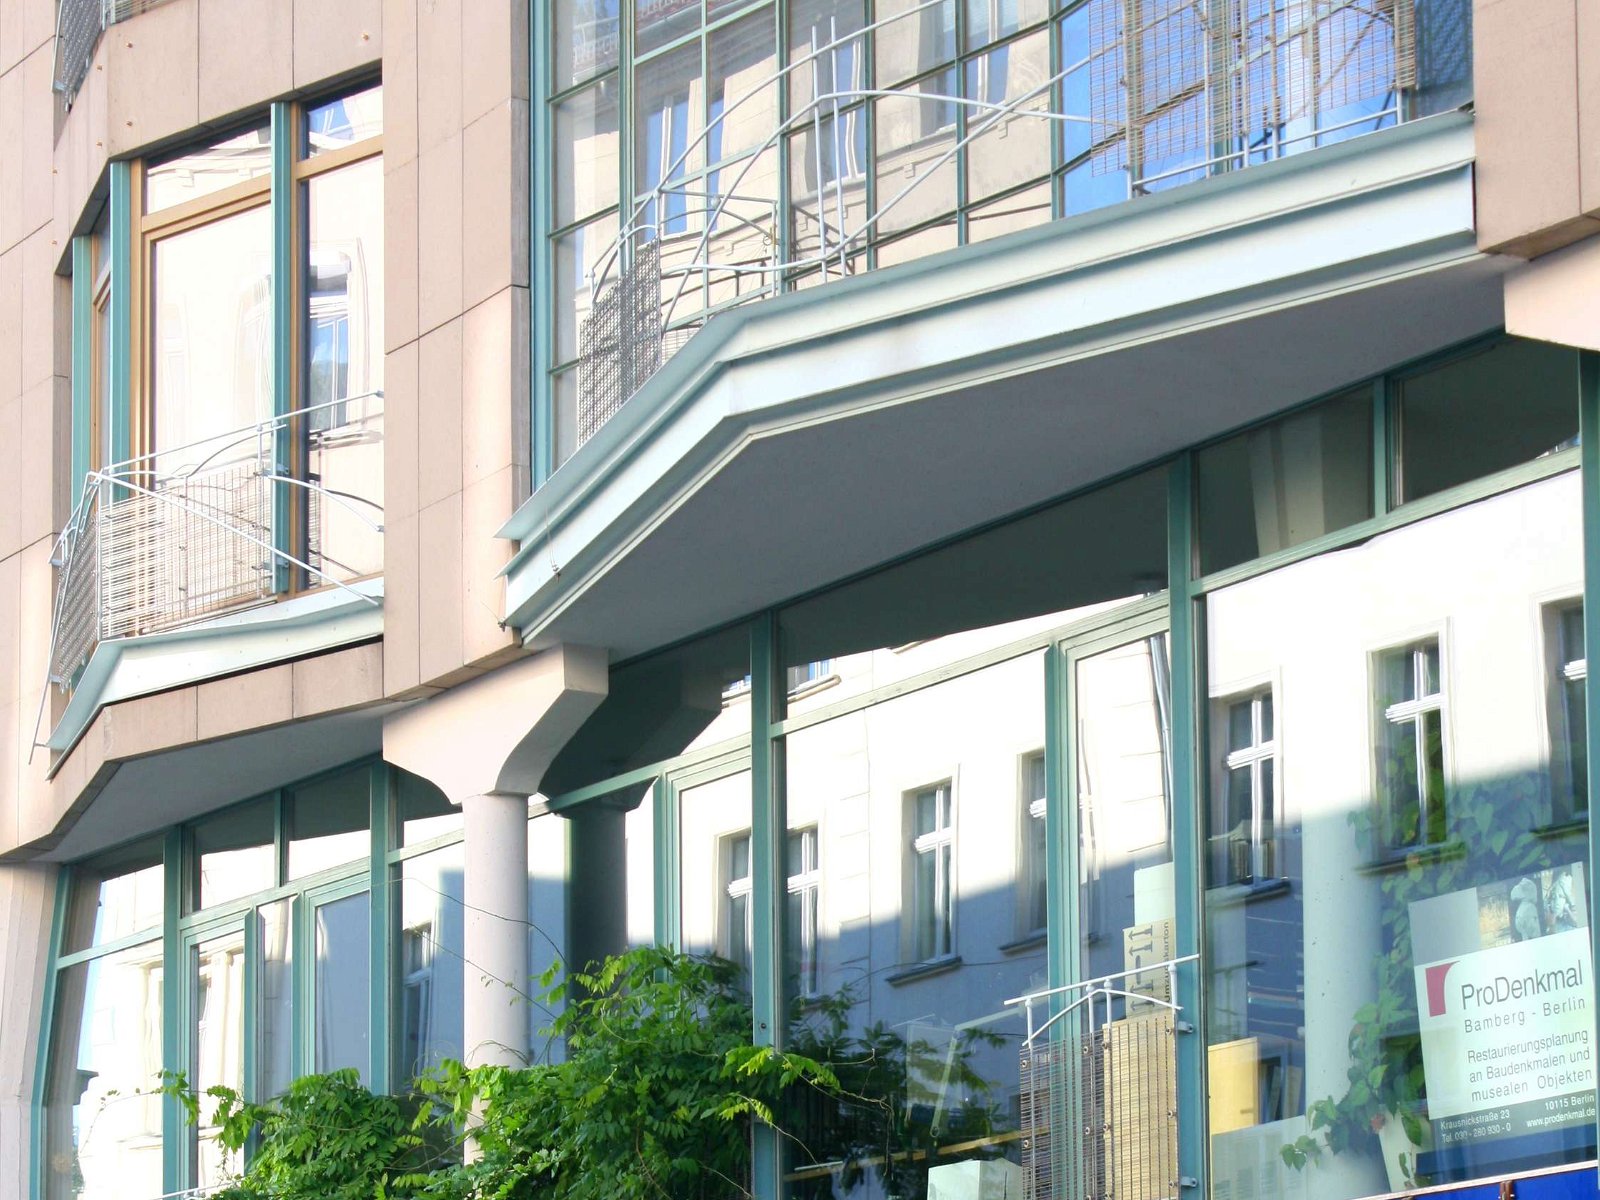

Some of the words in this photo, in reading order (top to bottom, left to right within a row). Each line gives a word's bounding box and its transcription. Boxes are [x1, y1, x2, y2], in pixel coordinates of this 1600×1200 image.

[1461, 959, 1583, 1010] ProDenkmal
[1464, 1009, 1526, 1033] Bamberg
[1543, 996, 1586, 1017] Berlin
[1467, 1028, 1589, 1064] Restaurierungsplanung
[1470, 1069, 1483, 1083] an
[1486, 1054, 1566, 1080] Baudenkmalen
[1569, 1046, 1591, 1064] und
[1471, 1079, 1528, 1102] musealen
[1537, 1067, 1592, 1090] Objekten
[1545, 1098, 1569, 1110] 10115
[1571, 1094, 1595, 1106] Berlin
[1500, 1109, 1510, 1119] 23
[1526, 1108, 1596, 1128] www.prodenkmal.de
